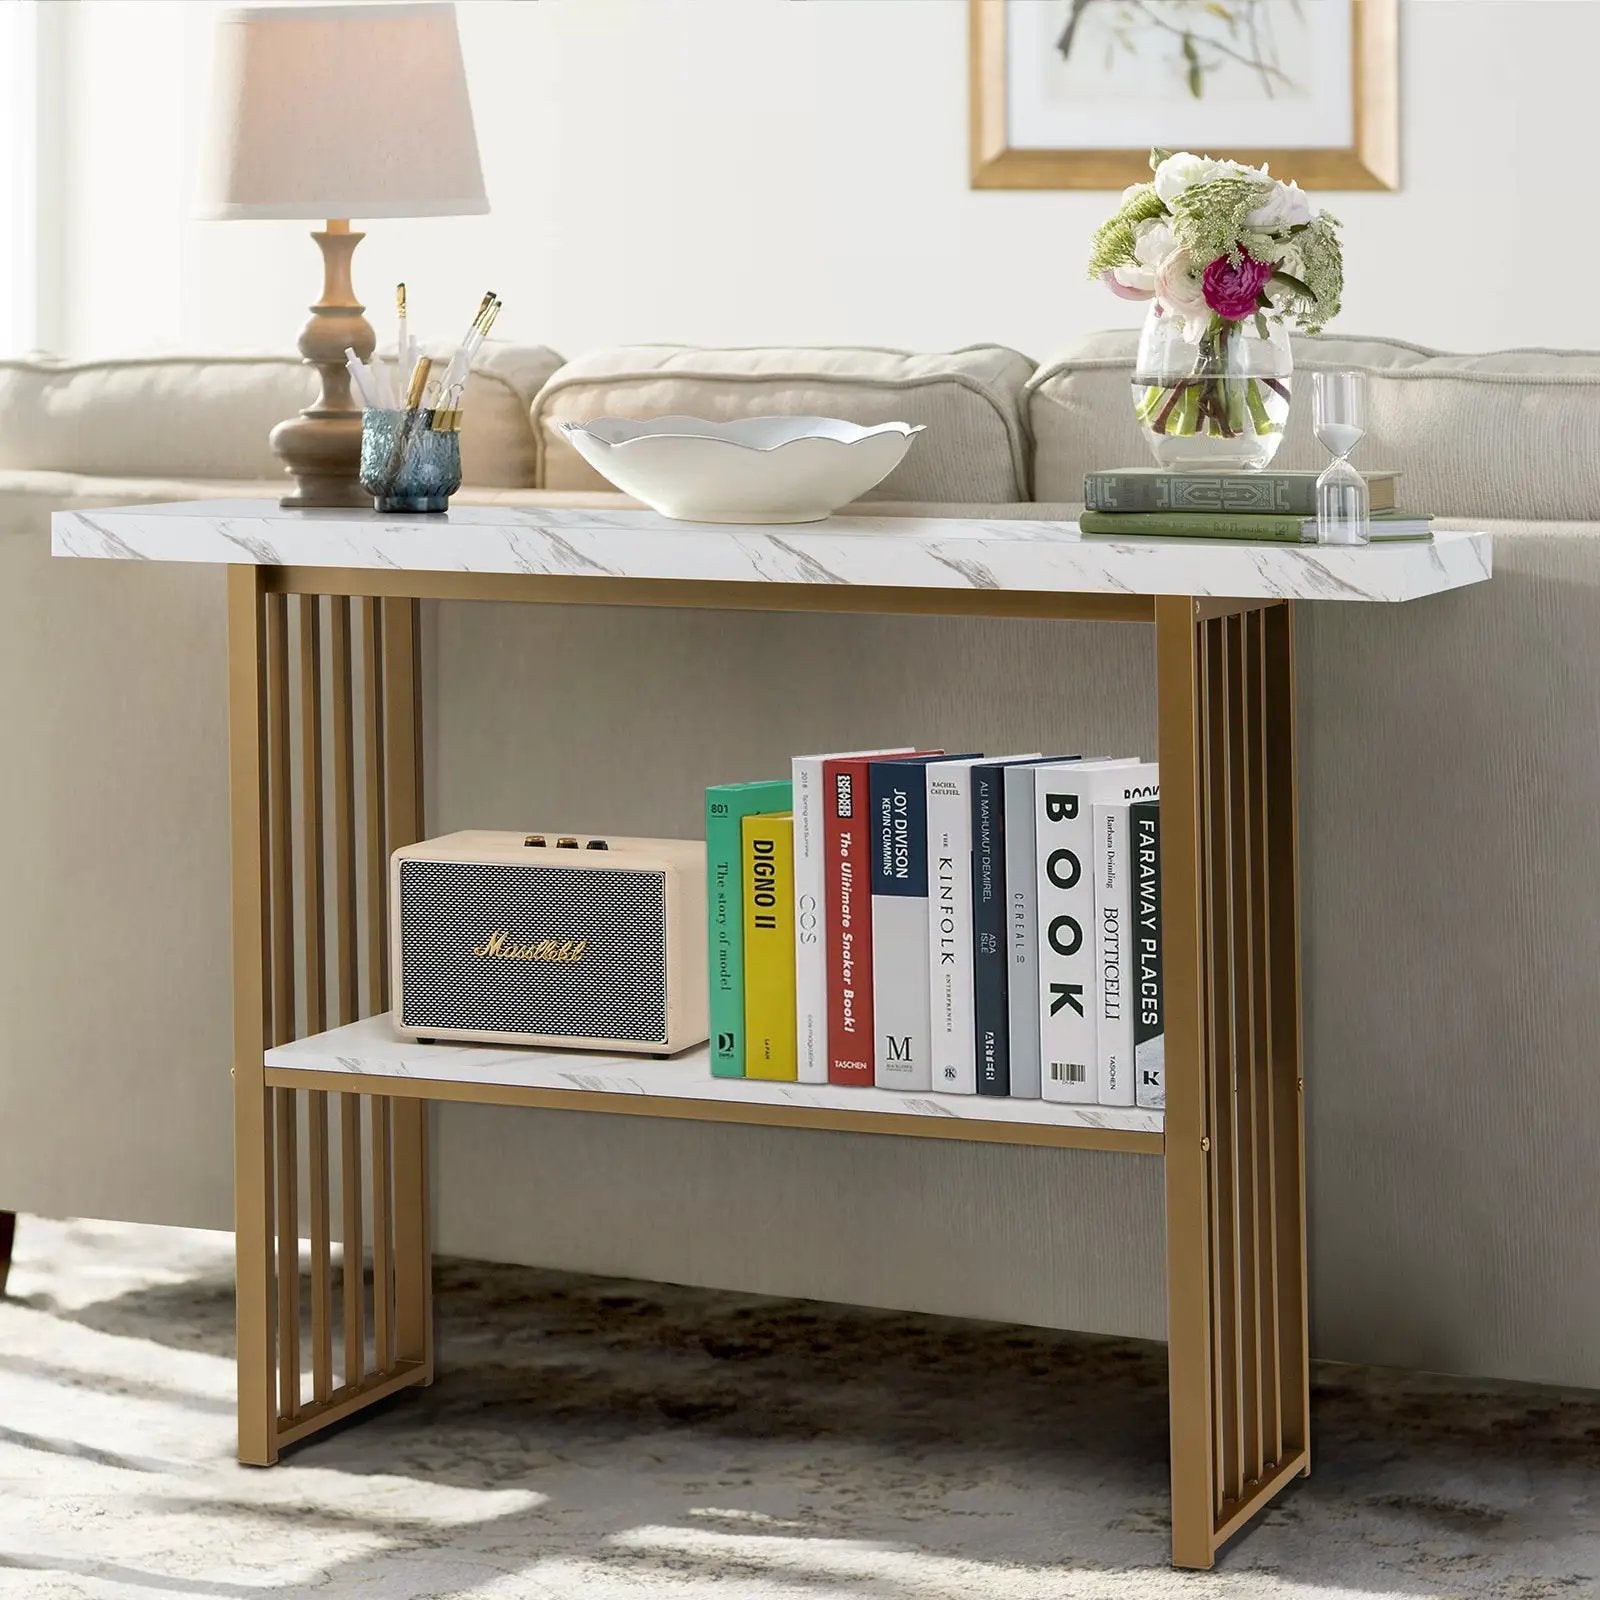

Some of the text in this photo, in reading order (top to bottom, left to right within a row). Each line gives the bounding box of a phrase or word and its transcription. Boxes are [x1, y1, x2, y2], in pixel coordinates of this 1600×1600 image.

[711, 804, 728, 814] 801
[932, 781, 956, 789] RACHEL
[882, 797, 892, 875] KEVIN CUMMINS
[893, 788, 908, 878] JOY DIVISON
[980, 781, 991, 902] ALI MAHUMUT DEMIREL
[1106, 816, 1116, 888] Barbara Deimling
[753, 840, 776, 929] DIGNO II
[800, 894, 816, 944] COS
[939, 858, 954, 966] KINFOLK
[1014, 893, 1025, 949] CEREAL
[1046, 793, 1084, 1018] BOOK
[1139, 820, 1158, 1025] FARAWAY PLACES
[717, 862, 732, 991] The story of model
[840, 832, 855, 1033] The Ulitimate Snaker Book!
[981, 933, 989, 953] ISLE
[1103, 907, 1120, 1021] BOTTICELLI
[834, 1061, 867, 1070] TASCHEN
[886, 1037, 912, 1062] M
